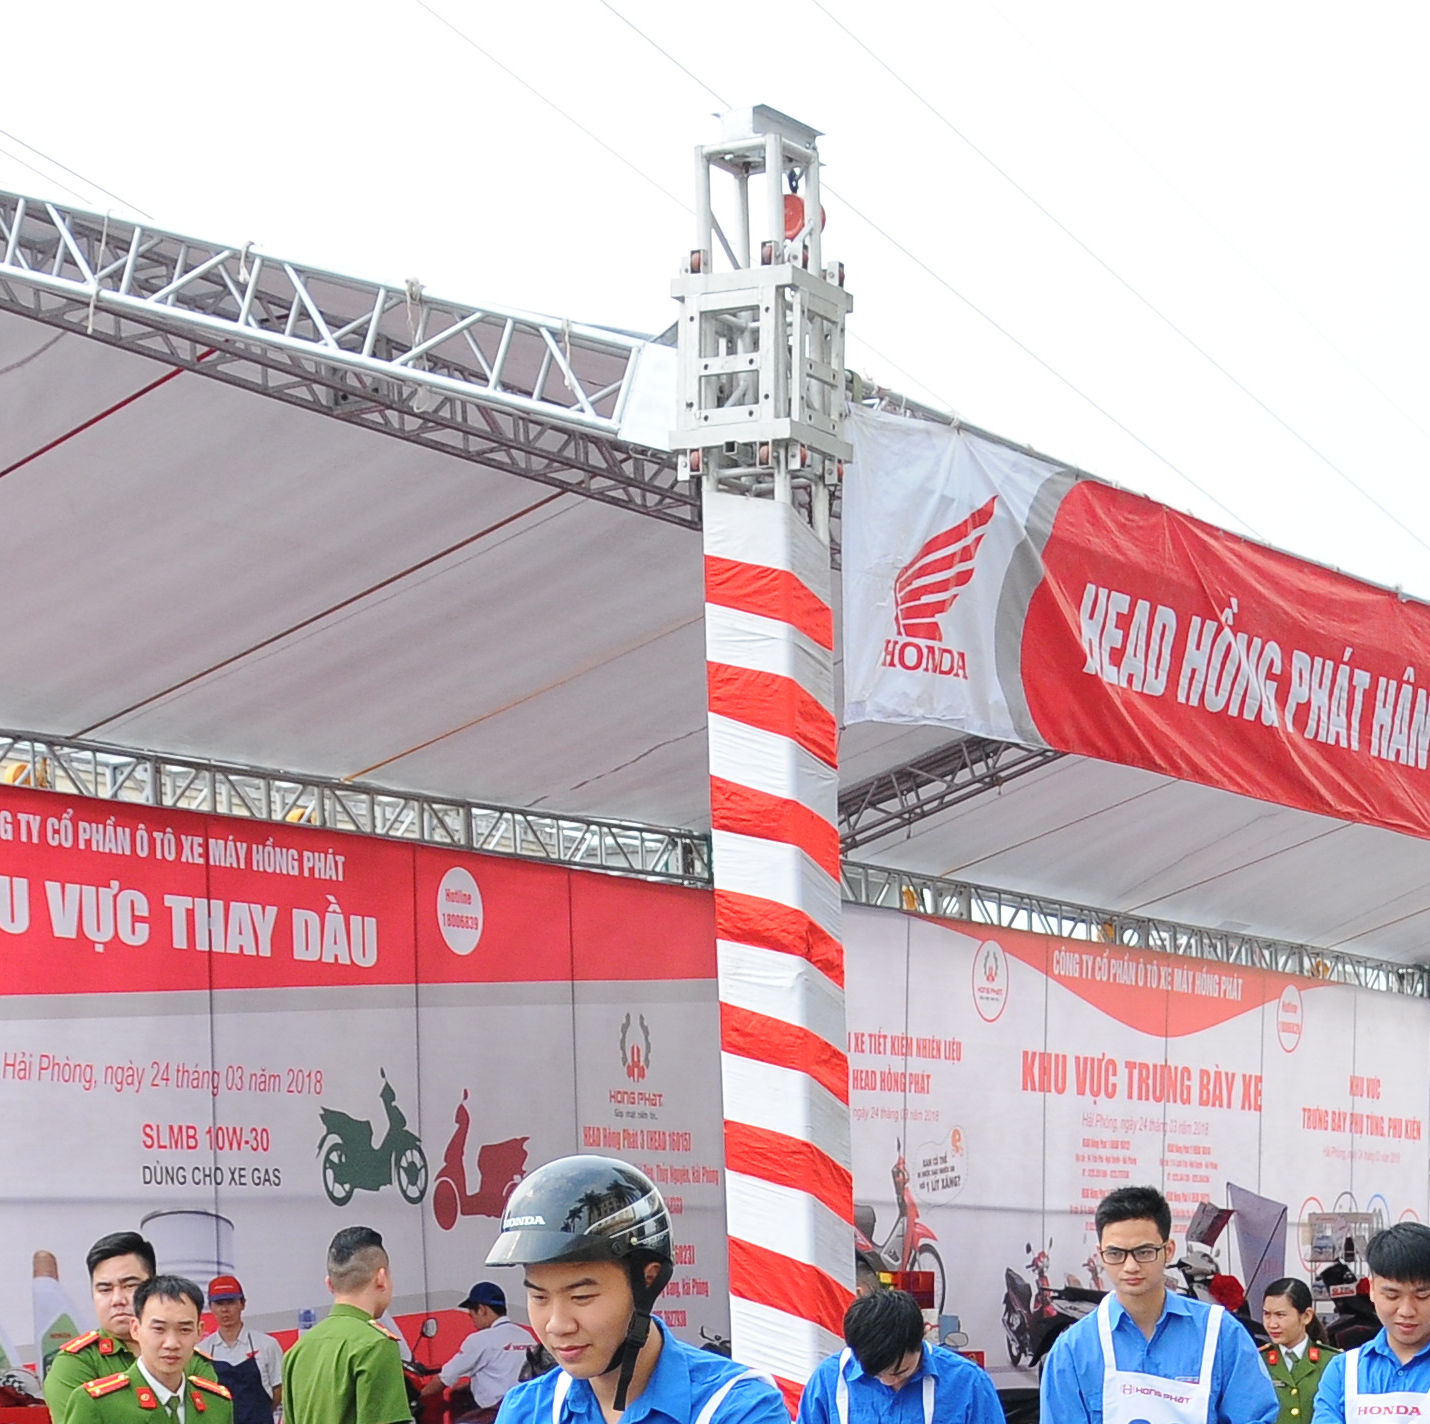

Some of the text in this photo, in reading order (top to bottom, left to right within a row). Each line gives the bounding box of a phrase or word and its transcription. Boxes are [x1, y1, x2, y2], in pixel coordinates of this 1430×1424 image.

[882, 639, 968, 681] HONDA
[1080, 582, 1178, 697] HEAD
[1177, 596, 1281, 727] HỒNG
[1286, 646, 1372, 752] PHÁT
[17, 813, 41, 844] TY
[46, 808, 73, 848] CỔ
[79, 816, 131, 856] PHẦN
[135, 823, 149, 858] Ô
[153, 827, 177, 861] TÔ
[180, 834, 205, 865] XE
[208, 834, 248, 870] MÁY
[252, 836, 299, 876] HỒNG
[303, 848, 345, 882] PHÁT
[44, 880, 150, 953] VỰC
[163, 893, 278, 958] THAY
[292, 894, 378, 968] DẦU
[1053, 946, 1079, 977] CÔNG
[1082, 955, 1093, 979] TY
[1110, 953, 1136, 986] PHẦN
[1137, 958, 1144, 987] Ô
[1146, 960, 1158, 989] TÔ
[1160, 967, 1171, 991] XE
[1174, 964, 1194, 994] MÁY
[1195, 965, 1219, 998] HỒNG
[1220, 972, 1243, 1001] PHÁT
[854, 1032, 865, 1054] XE
[868, 1027, 888, 1055] TIẾT
[891, 1033, 914, 1061] KIỆM
[916, 1034, 941, 1061] NHIÊN
[2, 1051, 323, 1097] Hải Phòng, ngày 24 tháng 03 năm 2018
[852, 1064, 931, 1095] HEAD HỒNG PHÁT
[1022, 1050, 1067, 1095] KHU
[1074, 1052, 1118, 1105] VỰC
[1198, 1064, 1236, 1110] BÀY
[1241, 1073, 1263, 1112] XE
[142, 1123, 270, 1152] SLMB 10W-30
[583, 1126, 601, 1147] HEAD
[142, 1161, 282, 1187] DÙNG CHO XE GAS
[1357, 1405, 1422, 1416] HONDA
